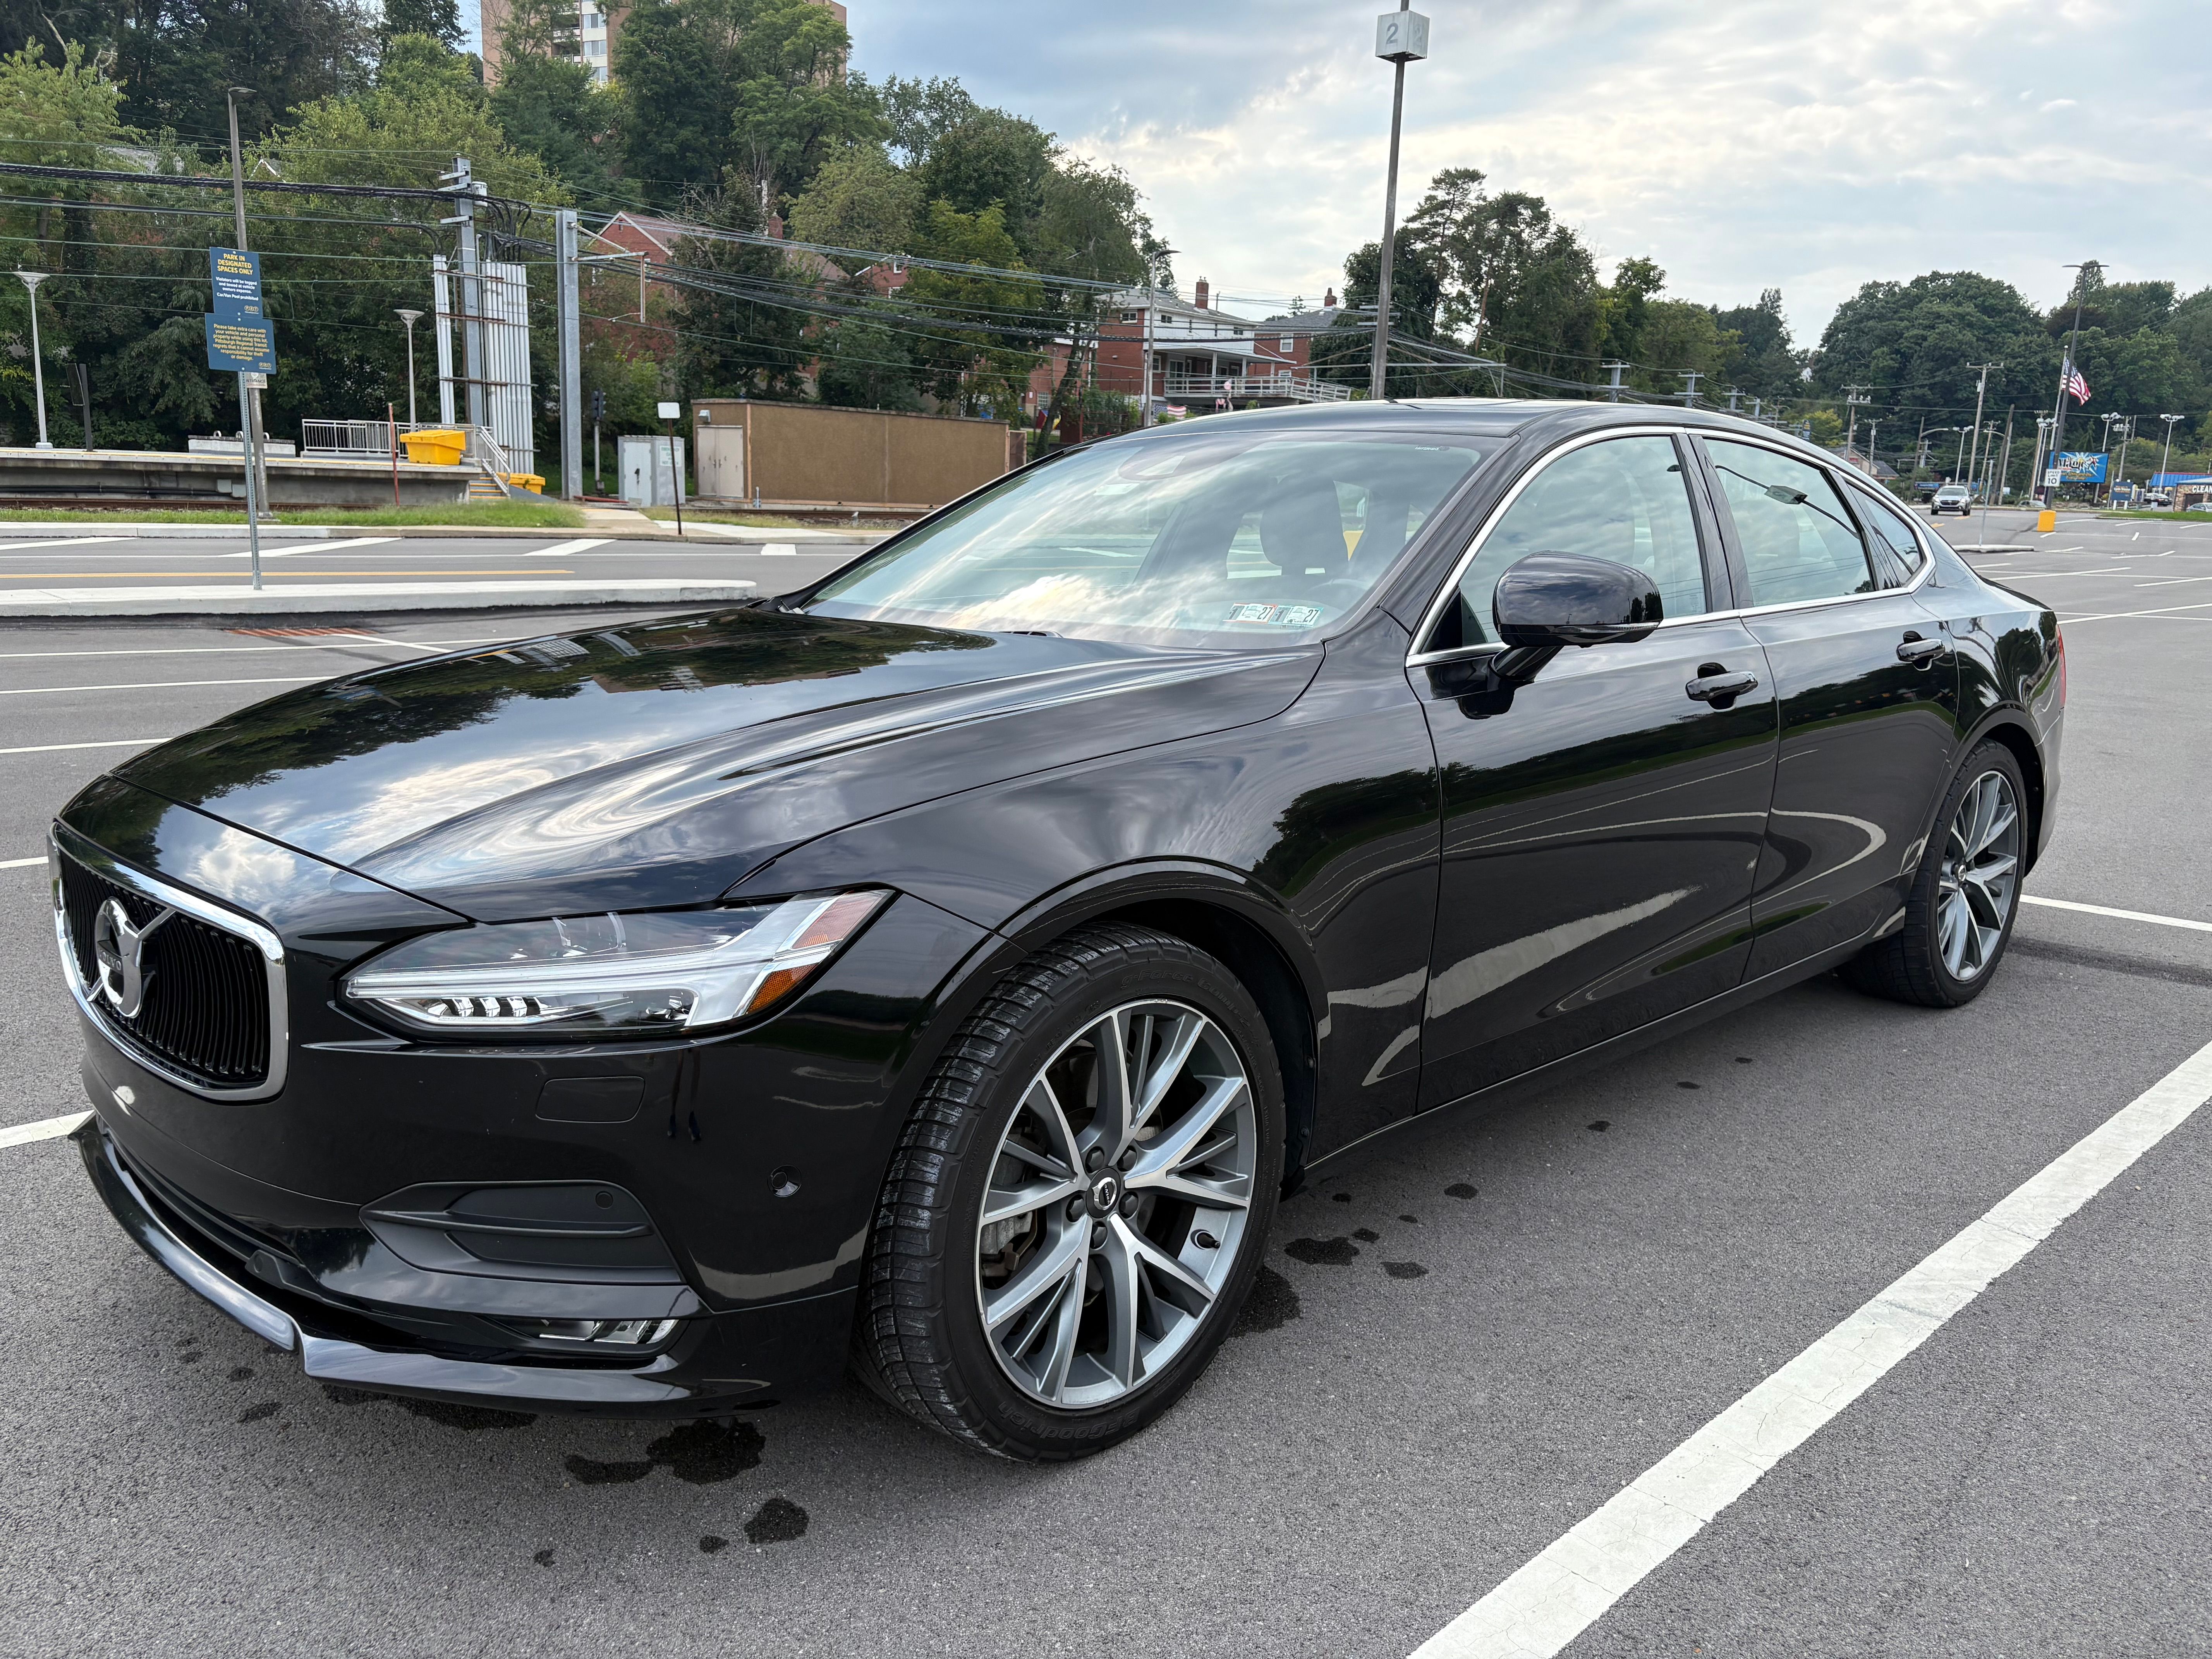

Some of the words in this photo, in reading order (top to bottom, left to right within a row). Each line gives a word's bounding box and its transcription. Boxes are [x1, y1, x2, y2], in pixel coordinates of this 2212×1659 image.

[1386, 22, 1398, 44] 2
[218, 259, 252, 268] DESIGNATED
[1257, 607, 1273, 620] 27
[1303, 610, 1319, 623] 27
[998, 1401, 1140, 1439] BFGoodrich
